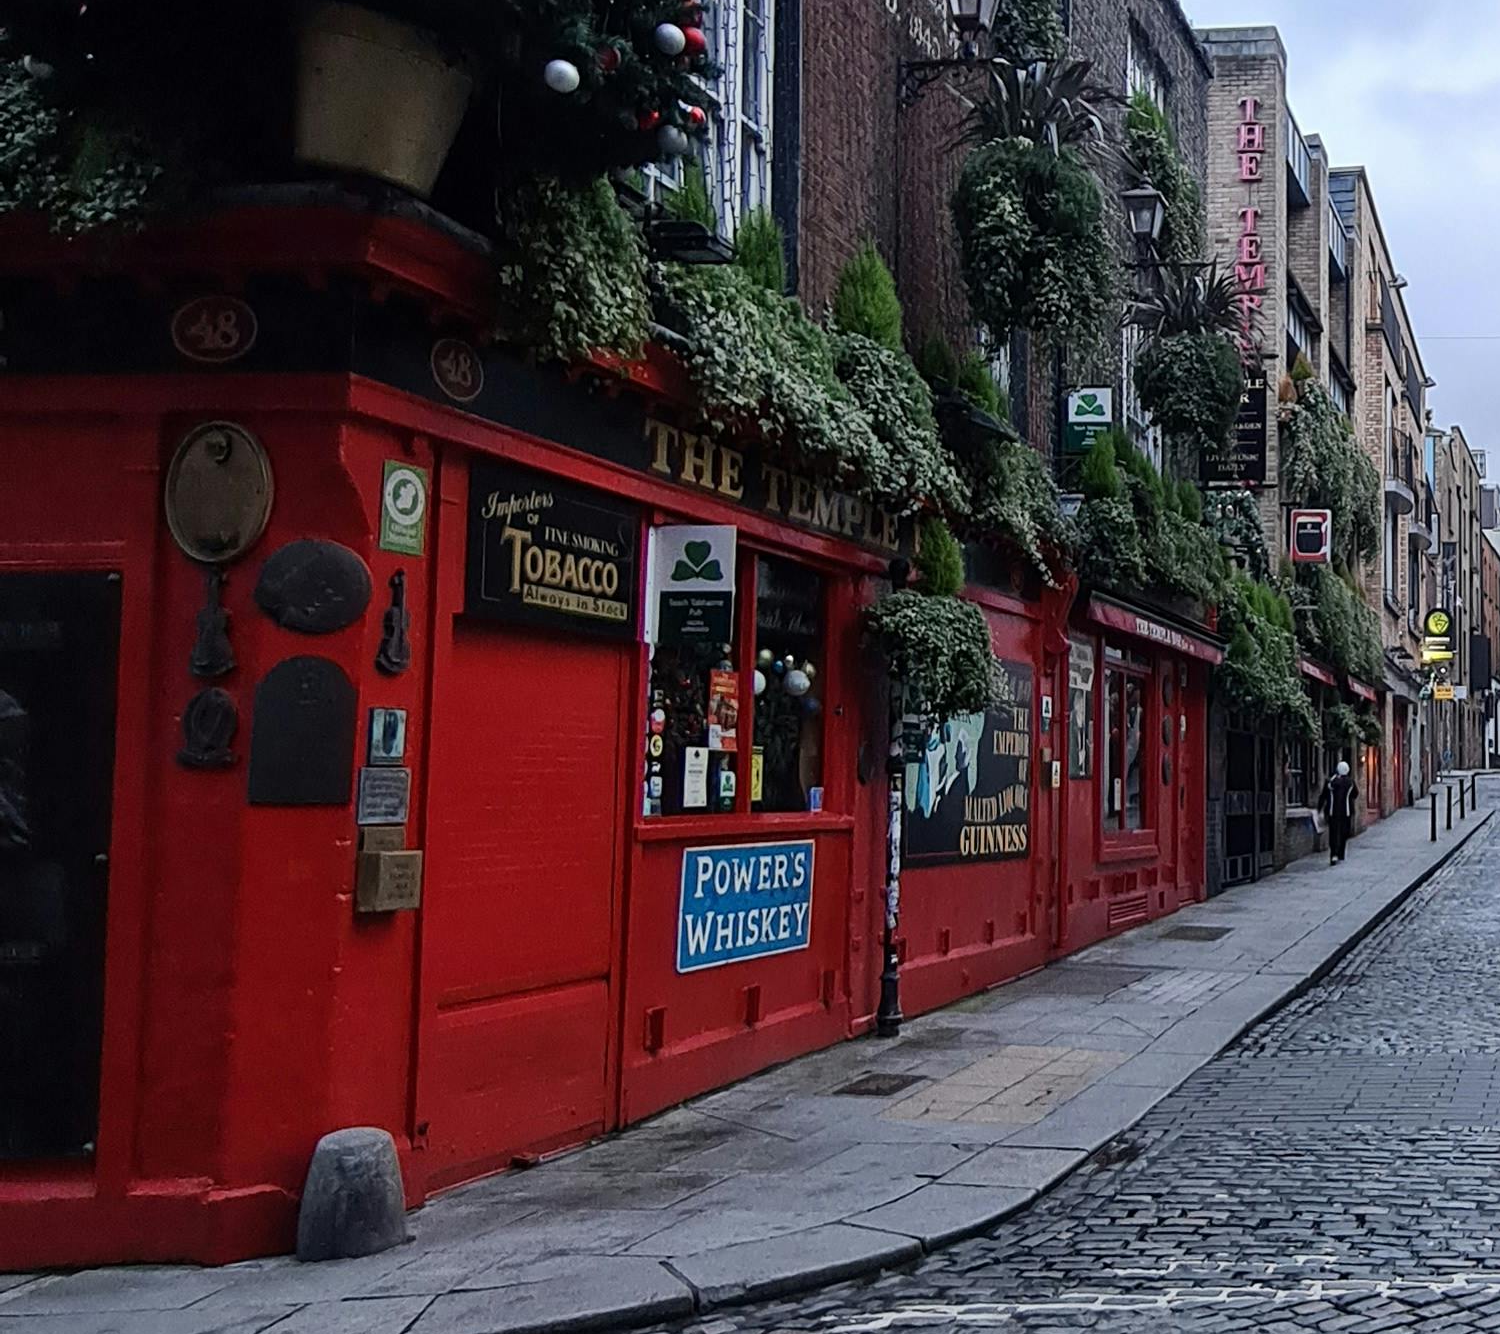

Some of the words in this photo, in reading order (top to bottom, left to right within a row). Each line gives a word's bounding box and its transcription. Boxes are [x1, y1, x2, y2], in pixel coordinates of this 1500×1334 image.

[1236, 95, 1266, 182] THE
[645, 417, 743, 498] THE
[762, 462, 899, 551] TEMPLE
[482, 490, 554, 525] Importers
[545, 525, 569, 547] FINE
[572, 534, 619, 557] SMOKING
[524, 586, 571, 609] Always
[576, 596, 588, 610] in
[592, 597, 626, 617] Stock
[1013, 706, 1029, 731] THE
[993, 731, 1030, 758] EMPEROR
[964, 795, 998, 823] MALTED
[959, 824, 1027, 856] GUINNESS
[694, 851, 806, 899] POWER'S
[684, 902, 809, 957] WHISKEY
